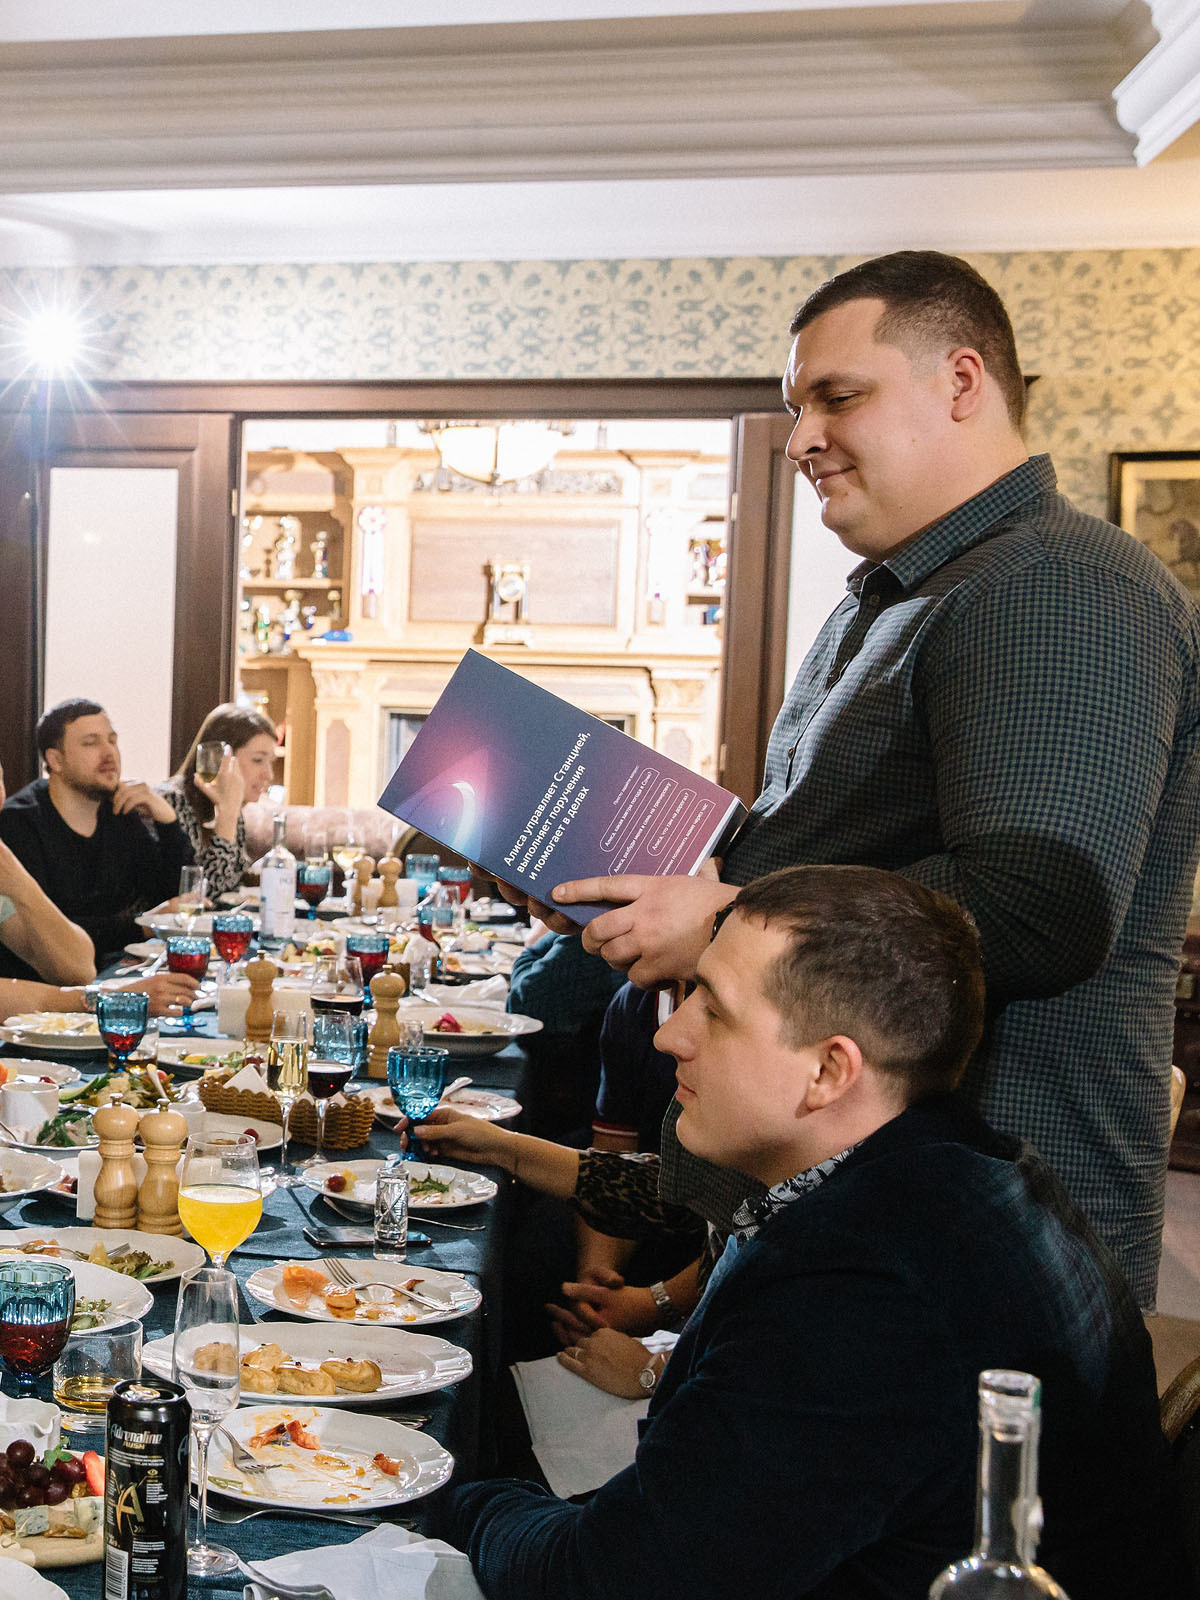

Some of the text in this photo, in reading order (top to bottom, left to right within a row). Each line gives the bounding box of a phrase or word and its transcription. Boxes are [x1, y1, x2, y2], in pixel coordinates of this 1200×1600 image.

[503, 732, 592, 867] Алиса управляет Станцией,
[516, 764, 587, 874] выполняет поручения
[604, 831, 617, 847] Алиса,
[629, 787, 643, 805] погода
[528, 785, 591, 881] и помогает в делах
[651, 835, 664, 850] Алиса,
[612, 858, 626, 873] Алиса,
[110, 1423, 163, 1445] Adrenaline
